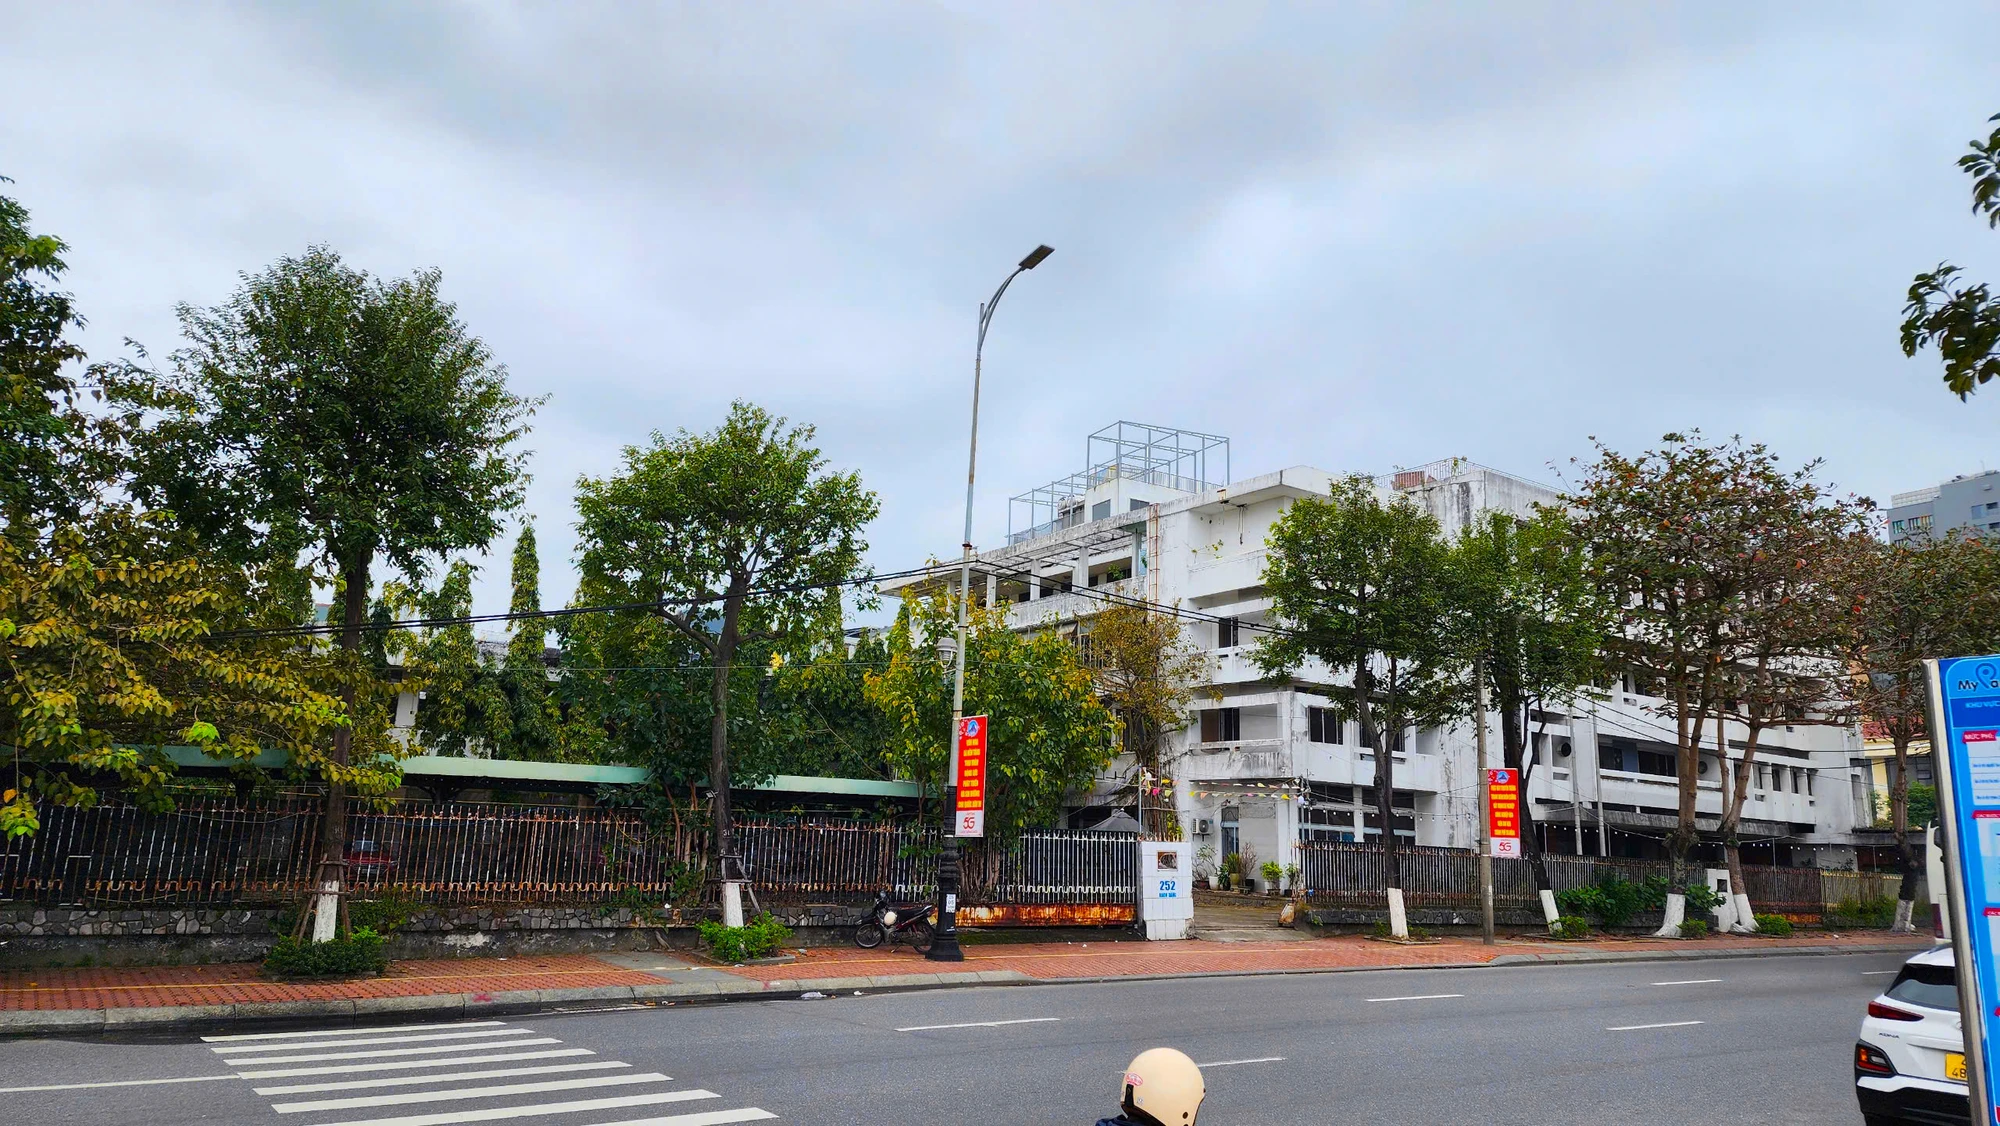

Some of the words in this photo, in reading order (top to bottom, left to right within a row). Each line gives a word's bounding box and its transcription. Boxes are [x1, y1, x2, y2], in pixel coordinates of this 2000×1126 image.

[1958, 680, 1978, 692] My
[963, 816, 975, 830] 5G
[1499, 842, 1512, 851] 5G
[1159, 880, 1176, 891] 252
[1952, 1068, 1967, 1079] 48
